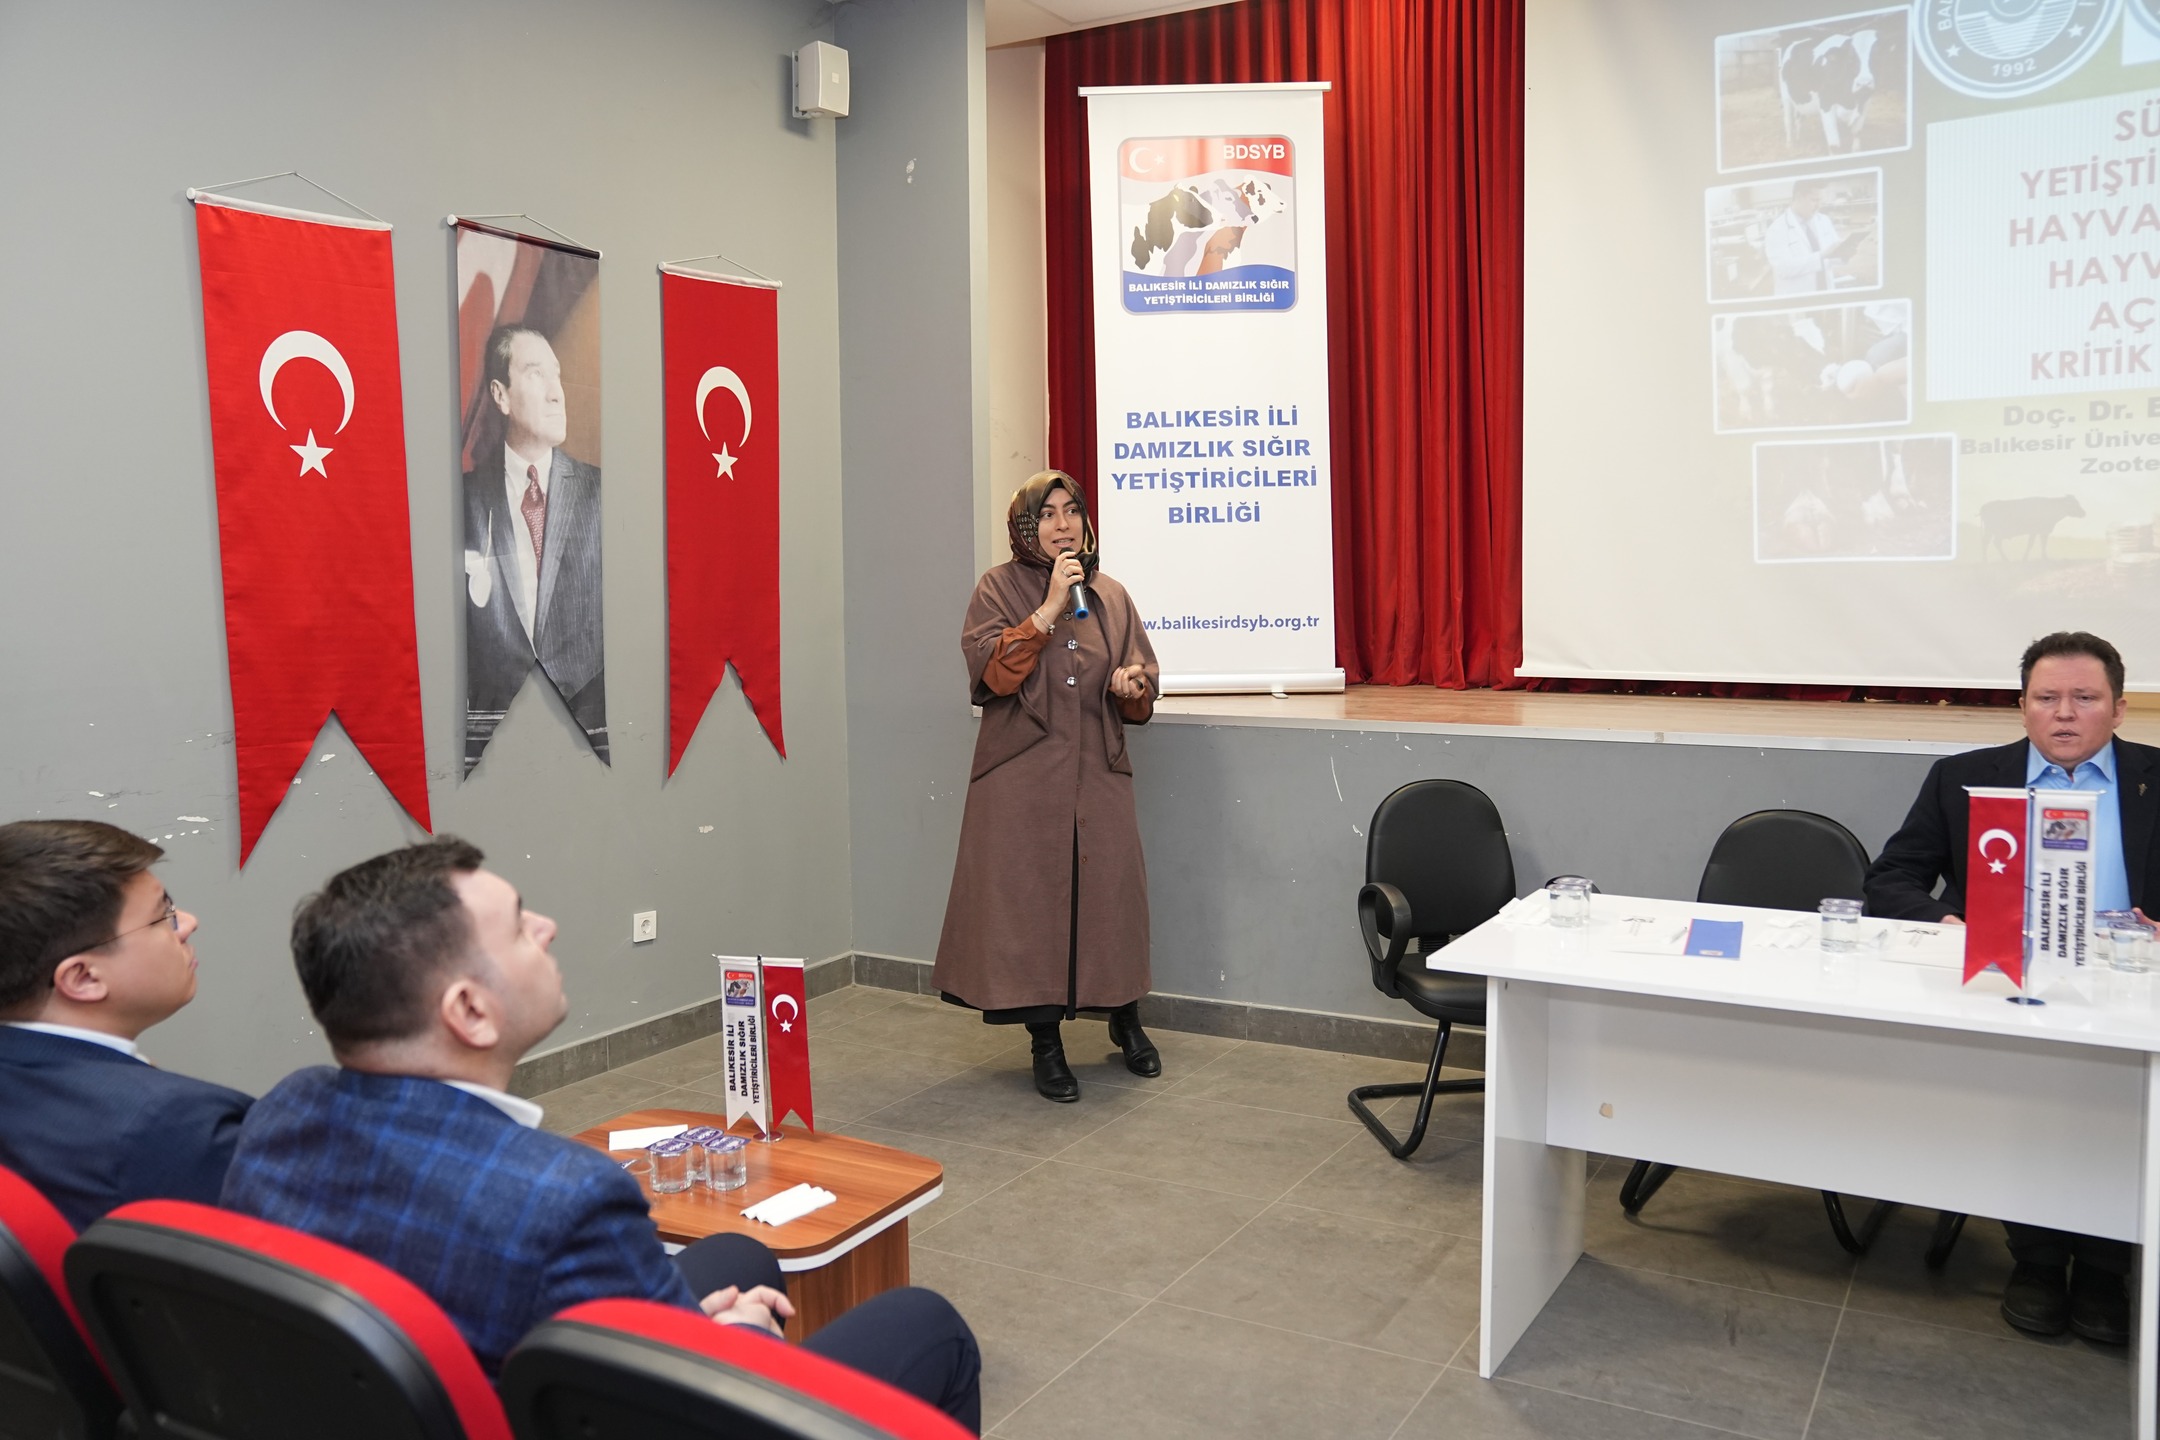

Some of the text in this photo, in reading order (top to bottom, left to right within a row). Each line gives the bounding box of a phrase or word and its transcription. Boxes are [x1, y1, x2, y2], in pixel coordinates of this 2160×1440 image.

[1991, 57, 2037, 78] 1992
[2113, 97, 2160, 141] SÜ
[1223, 144, 1285, 160] BDSYB
[2020, 147, 2156, 200] YETİŞTİ
[2009, 203, 2160, 247] HAYVA
[2049, 251, 2160, 289] HAYV
[1128, 278, 1289, 292] BALIKESİR İLİ DAMIZLIK SIĞIR
[1144, 292, 1275, 305] YETİŞTİRİCİLERİ BİRLİĞİ
[2089, 297, 2156, 334] AÇ
[2031, 339, 2153, 381] KRİTİK
[1126, 404, 1298, 429] BALIKESİR İLİ
[2003, 405, 2076, 429] Doç.
[2089, 400, 2133, 421] Dr.
[1114, 435, 1311, 460] DAMIZLIK SIĞIR
[1960, 428, 2160, 455] Balıkesir Ünive
[1111, 465, 1317, 494] YETİŞTİRİCİLERİ
[2080, 456, 2160, 474] Zoote
[1168, 501, 1261, 524] BİRLİĞİ
[2057, 903, 2068, 958] DAMIZLIK
[726, 1024, 736, 1091] BALIKESİR İLİ
[737, 1020, 748, 1097] DAMIZLIK SIĞIR
